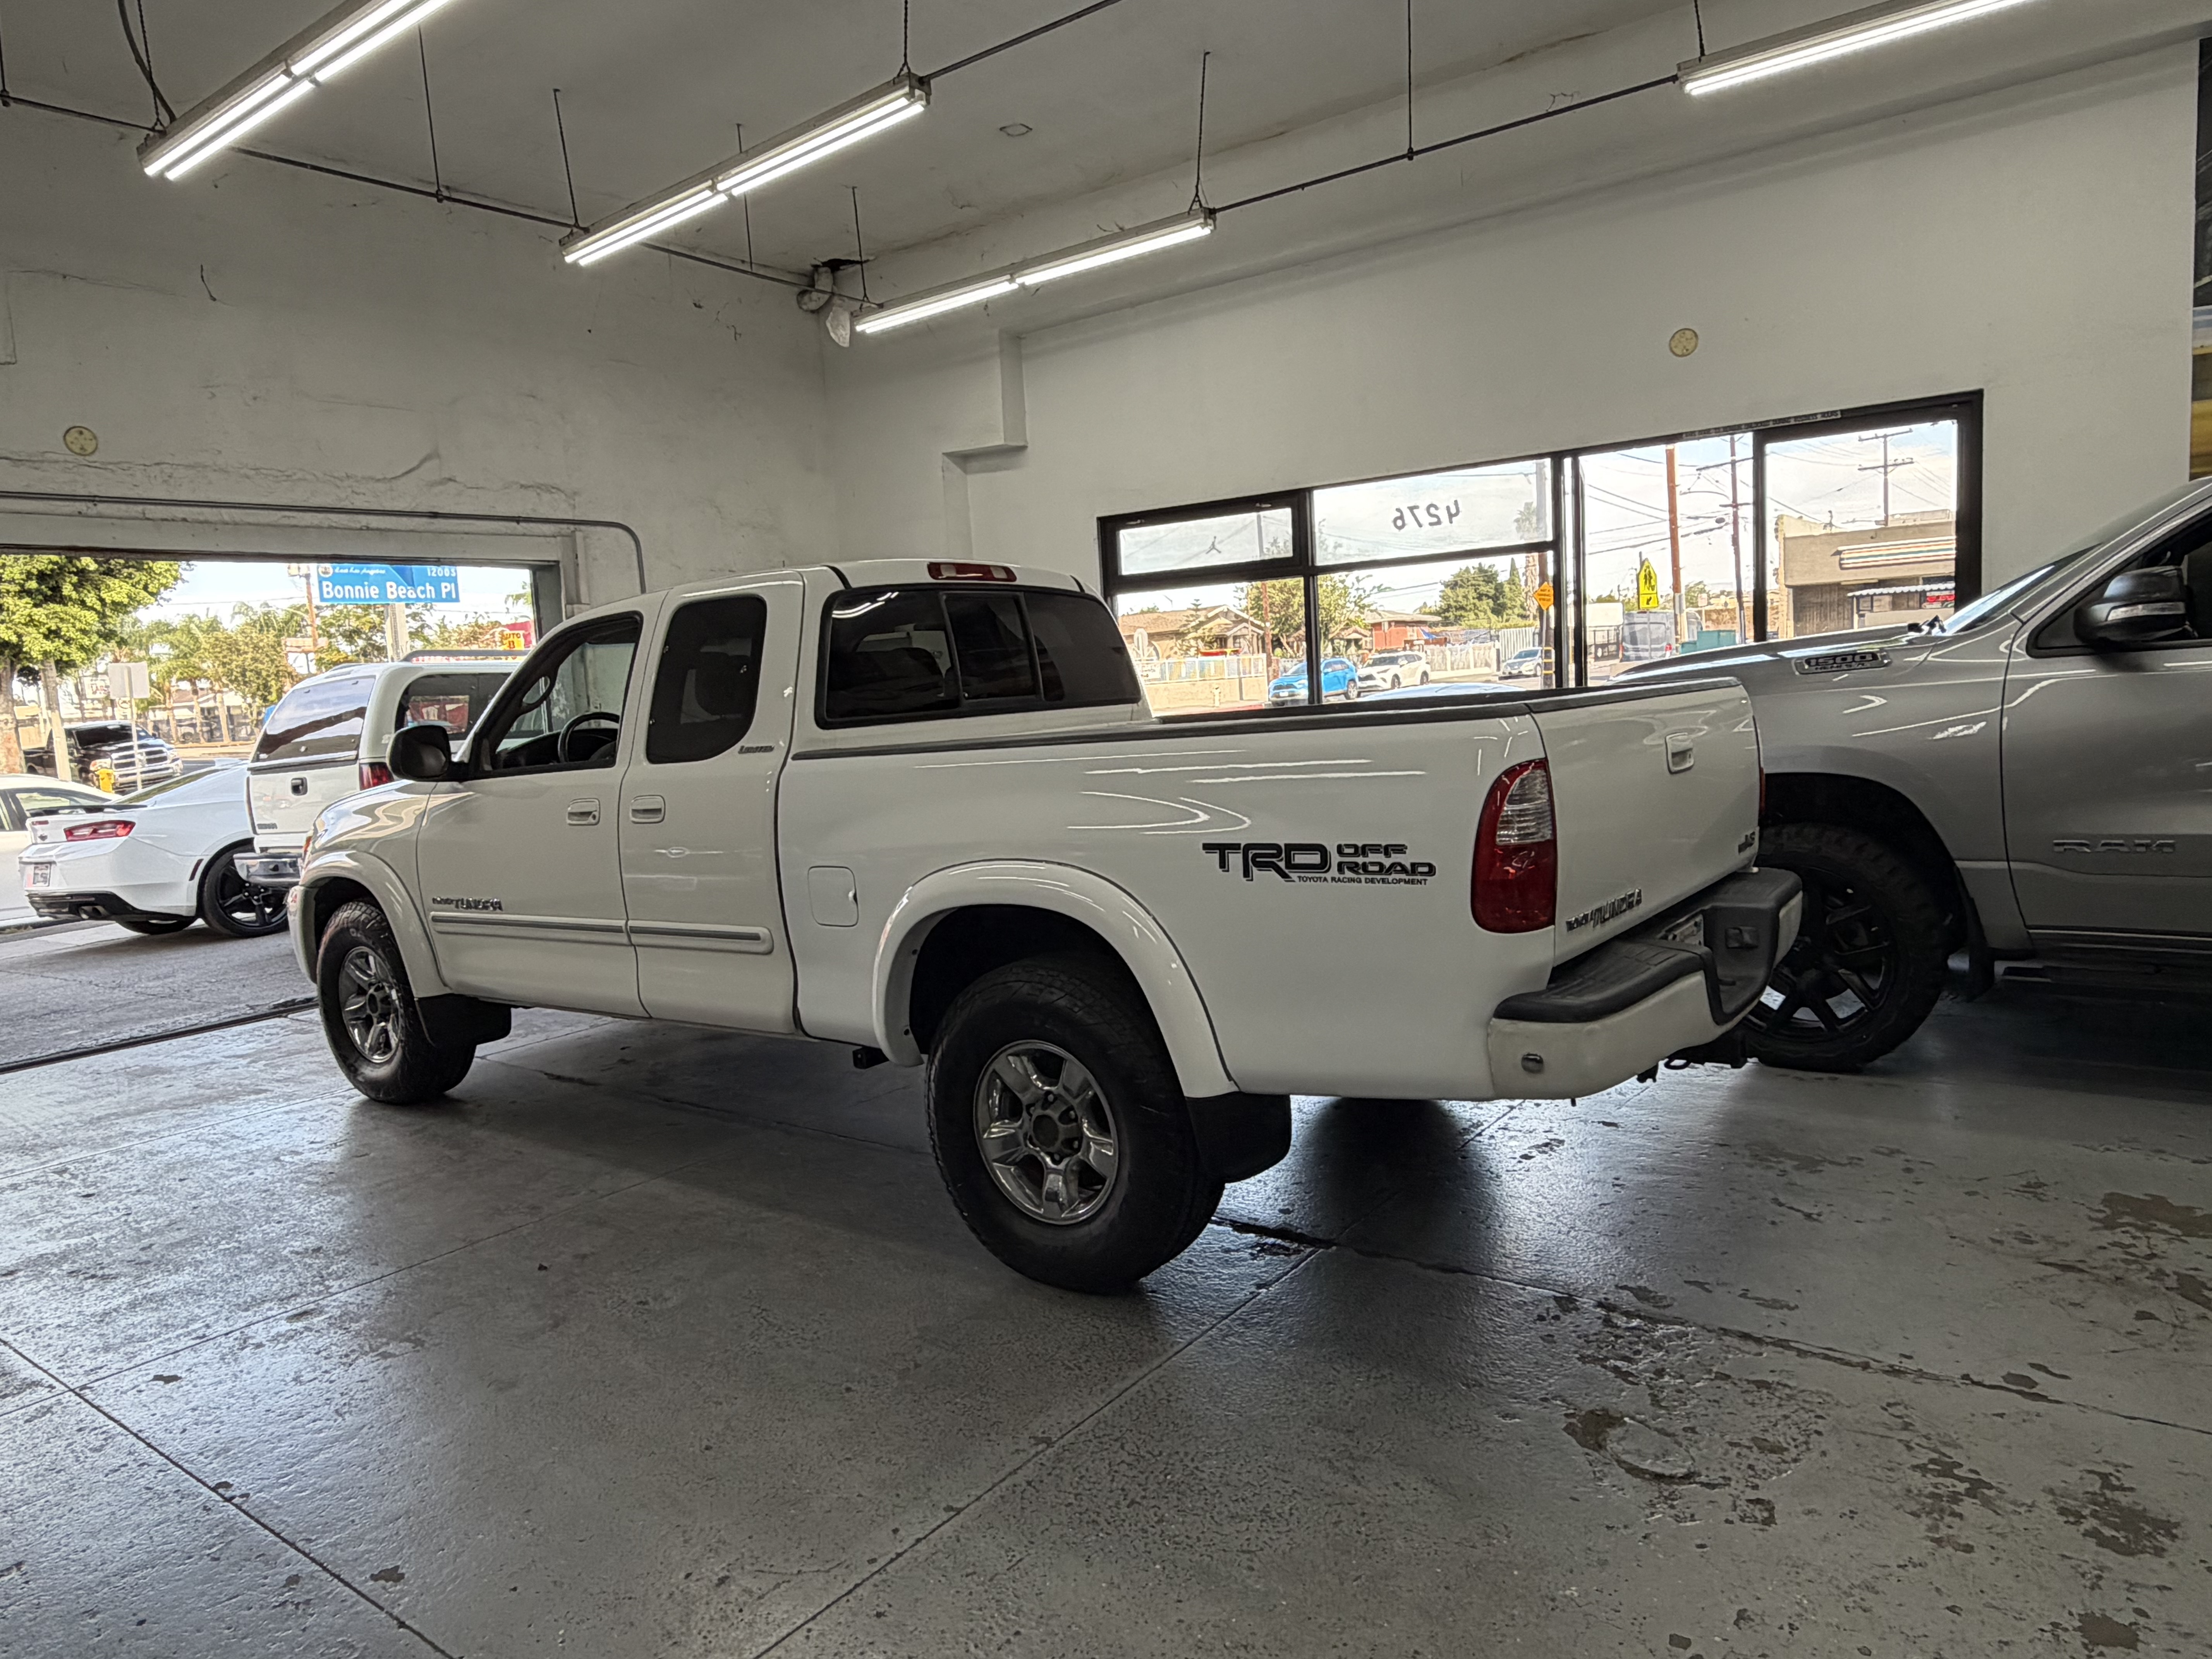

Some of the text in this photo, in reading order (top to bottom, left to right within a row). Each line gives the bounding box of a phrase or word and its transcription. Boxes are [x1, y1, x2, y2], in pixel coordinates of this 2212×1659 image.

[322, 581, 380, 599] Bonnie
[386, 581, 435, 599] Beach
[1809, 653, 1873, 666] 1500
[1202, 843, 1408, 882] TRD OFF
[1337, 861, 1436, 877] ROAD
[1364, 877, 1428, 885] DEVELOPMENT
